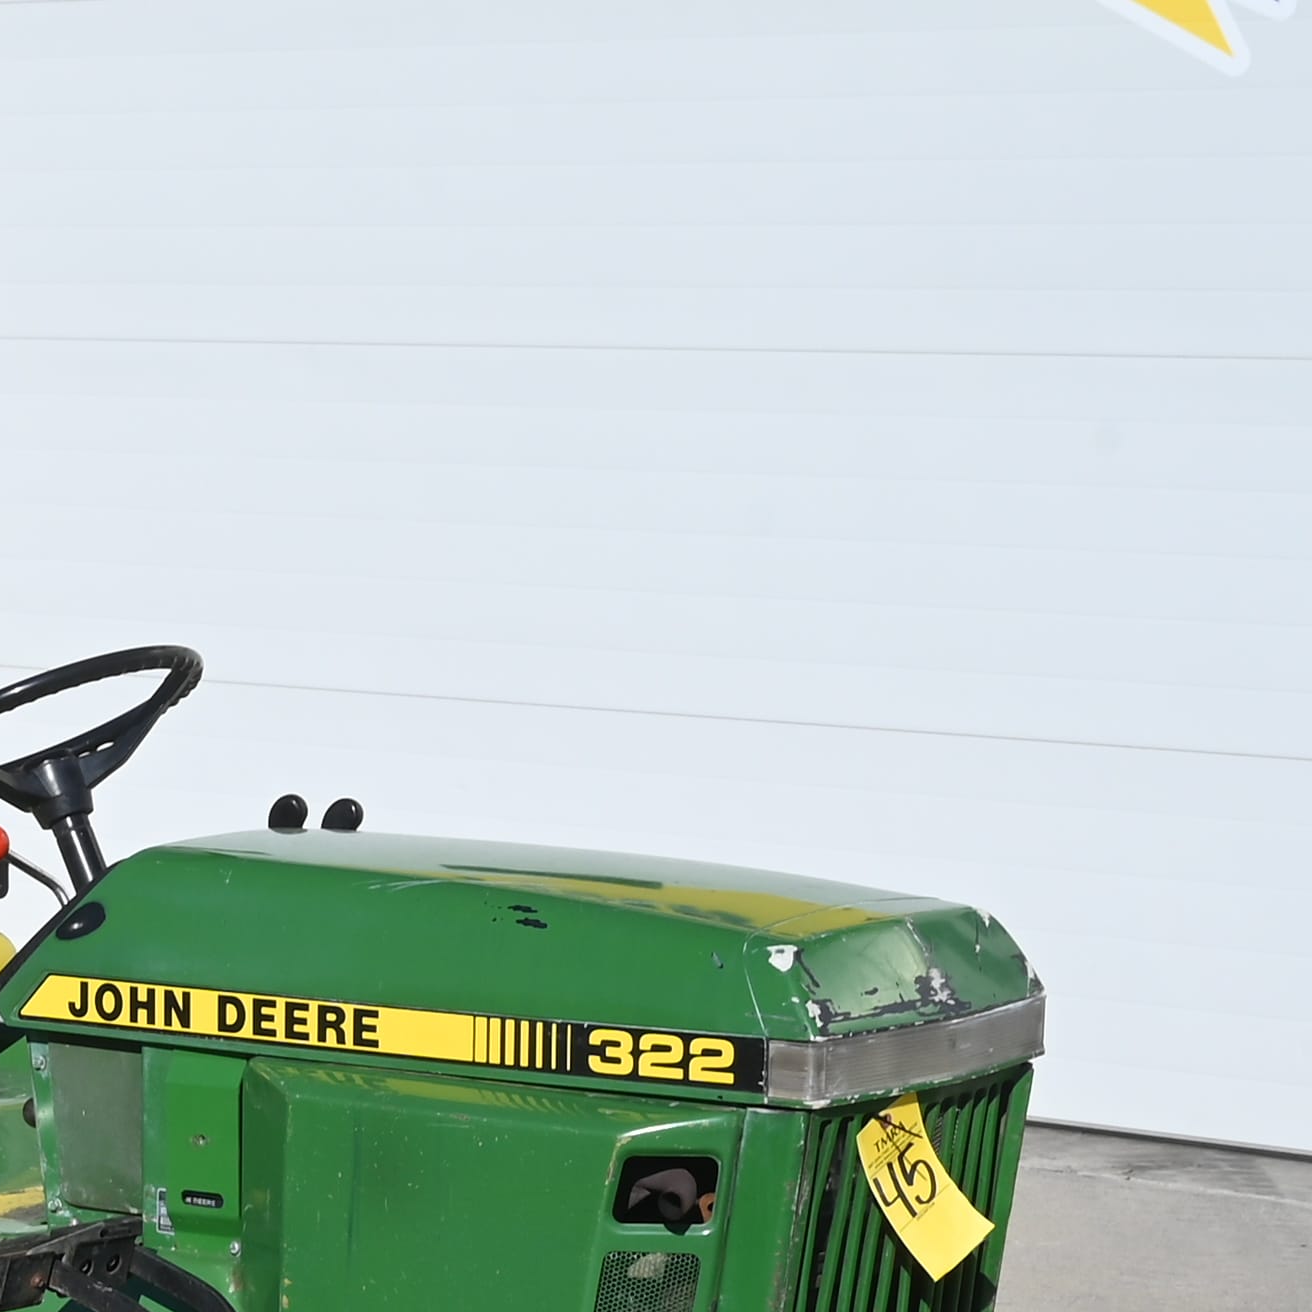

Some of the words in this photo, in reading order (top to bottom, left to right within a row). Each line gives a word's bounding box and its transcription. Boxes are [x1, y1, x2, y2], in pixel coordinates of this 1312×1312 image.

[68, 981, 191, 1029] JOHN
[218, 994, 379, 1048] DEERE
[588, 1028, 735, 1085] 322
[872, 1141, 937, 1218] 45
